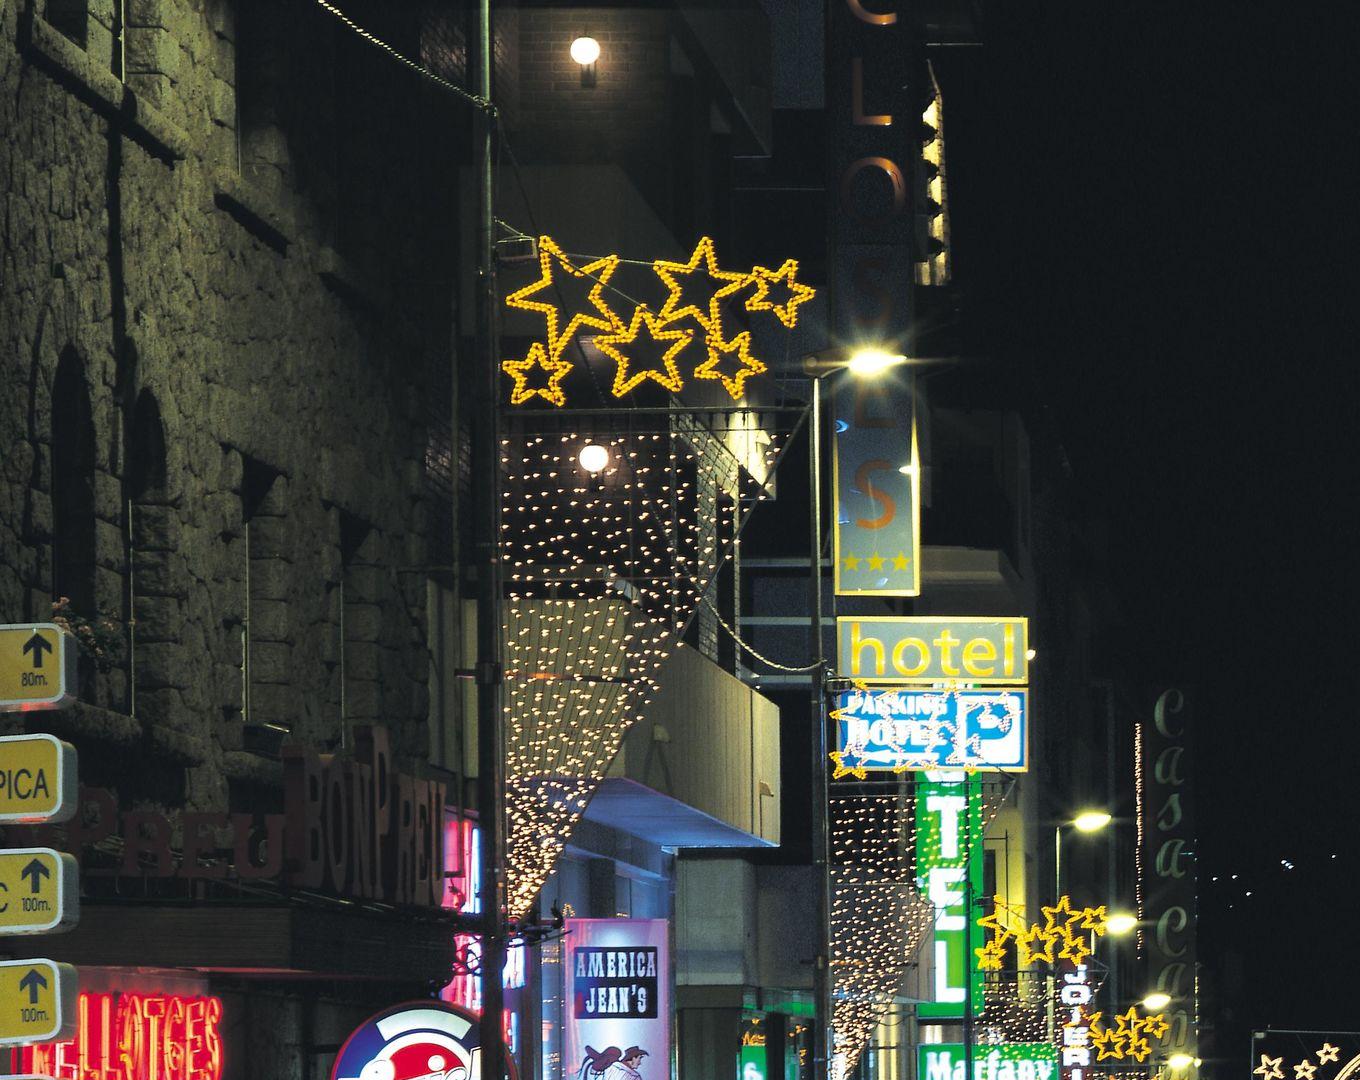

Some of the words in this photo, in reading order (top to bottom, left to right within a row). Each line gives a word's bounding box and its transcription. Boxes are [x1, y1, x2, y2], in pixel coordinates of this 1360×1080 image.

[851, 622, 1015, 676] hotel
[21, 672, 48, 687] 80m.
[1153, 687, 1186, 880] Casa
[22, 897, 51, 912] 100m.
[576, 951, 656, 978] AMERICA
[585, 985, 648, 1014] JEAN'S
[20, 1008, 49, 1023] 100m.
